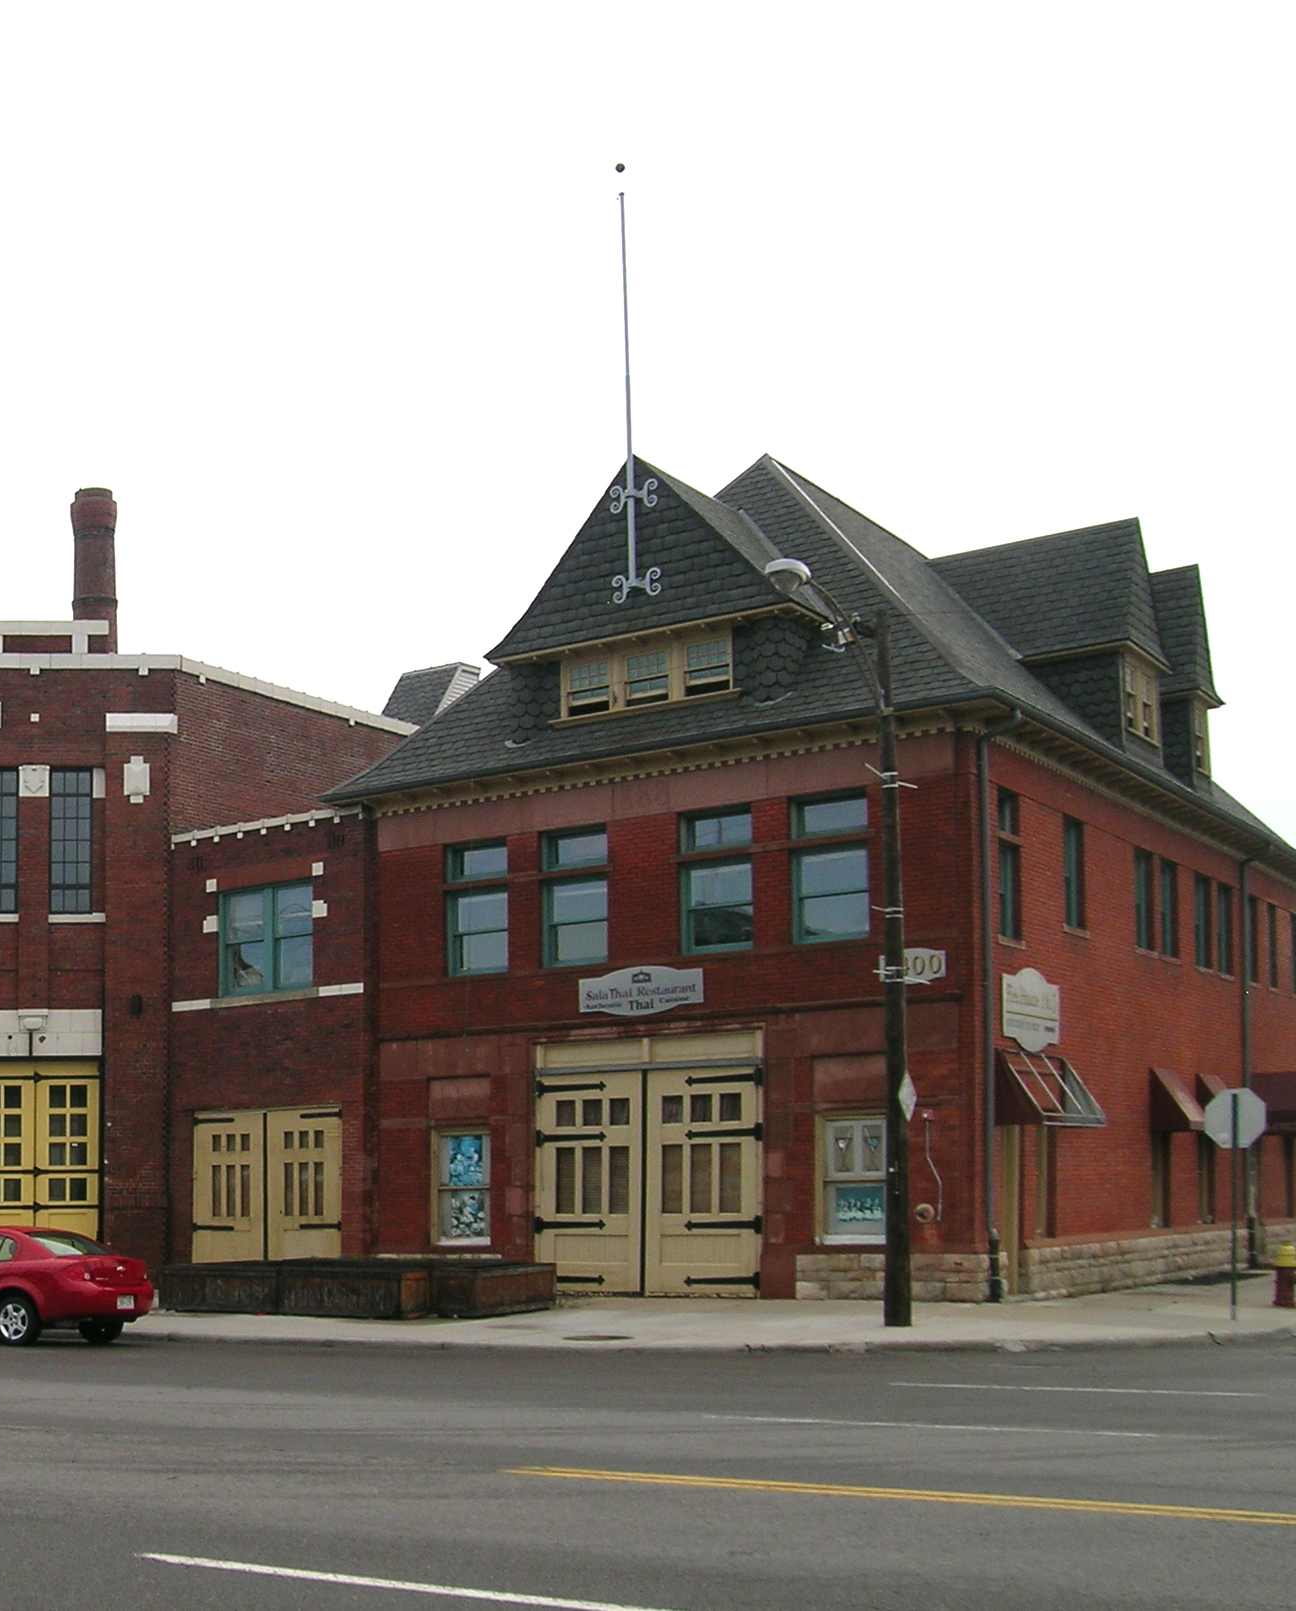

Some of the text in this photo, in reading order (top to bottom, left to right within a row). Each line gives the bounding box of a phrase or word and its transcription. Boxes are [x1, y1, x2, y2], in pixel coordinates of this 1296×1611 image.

[585, 983, 696, 1001] Sala Thai Restaurant
[628, 998, 654, 1011] Thai
